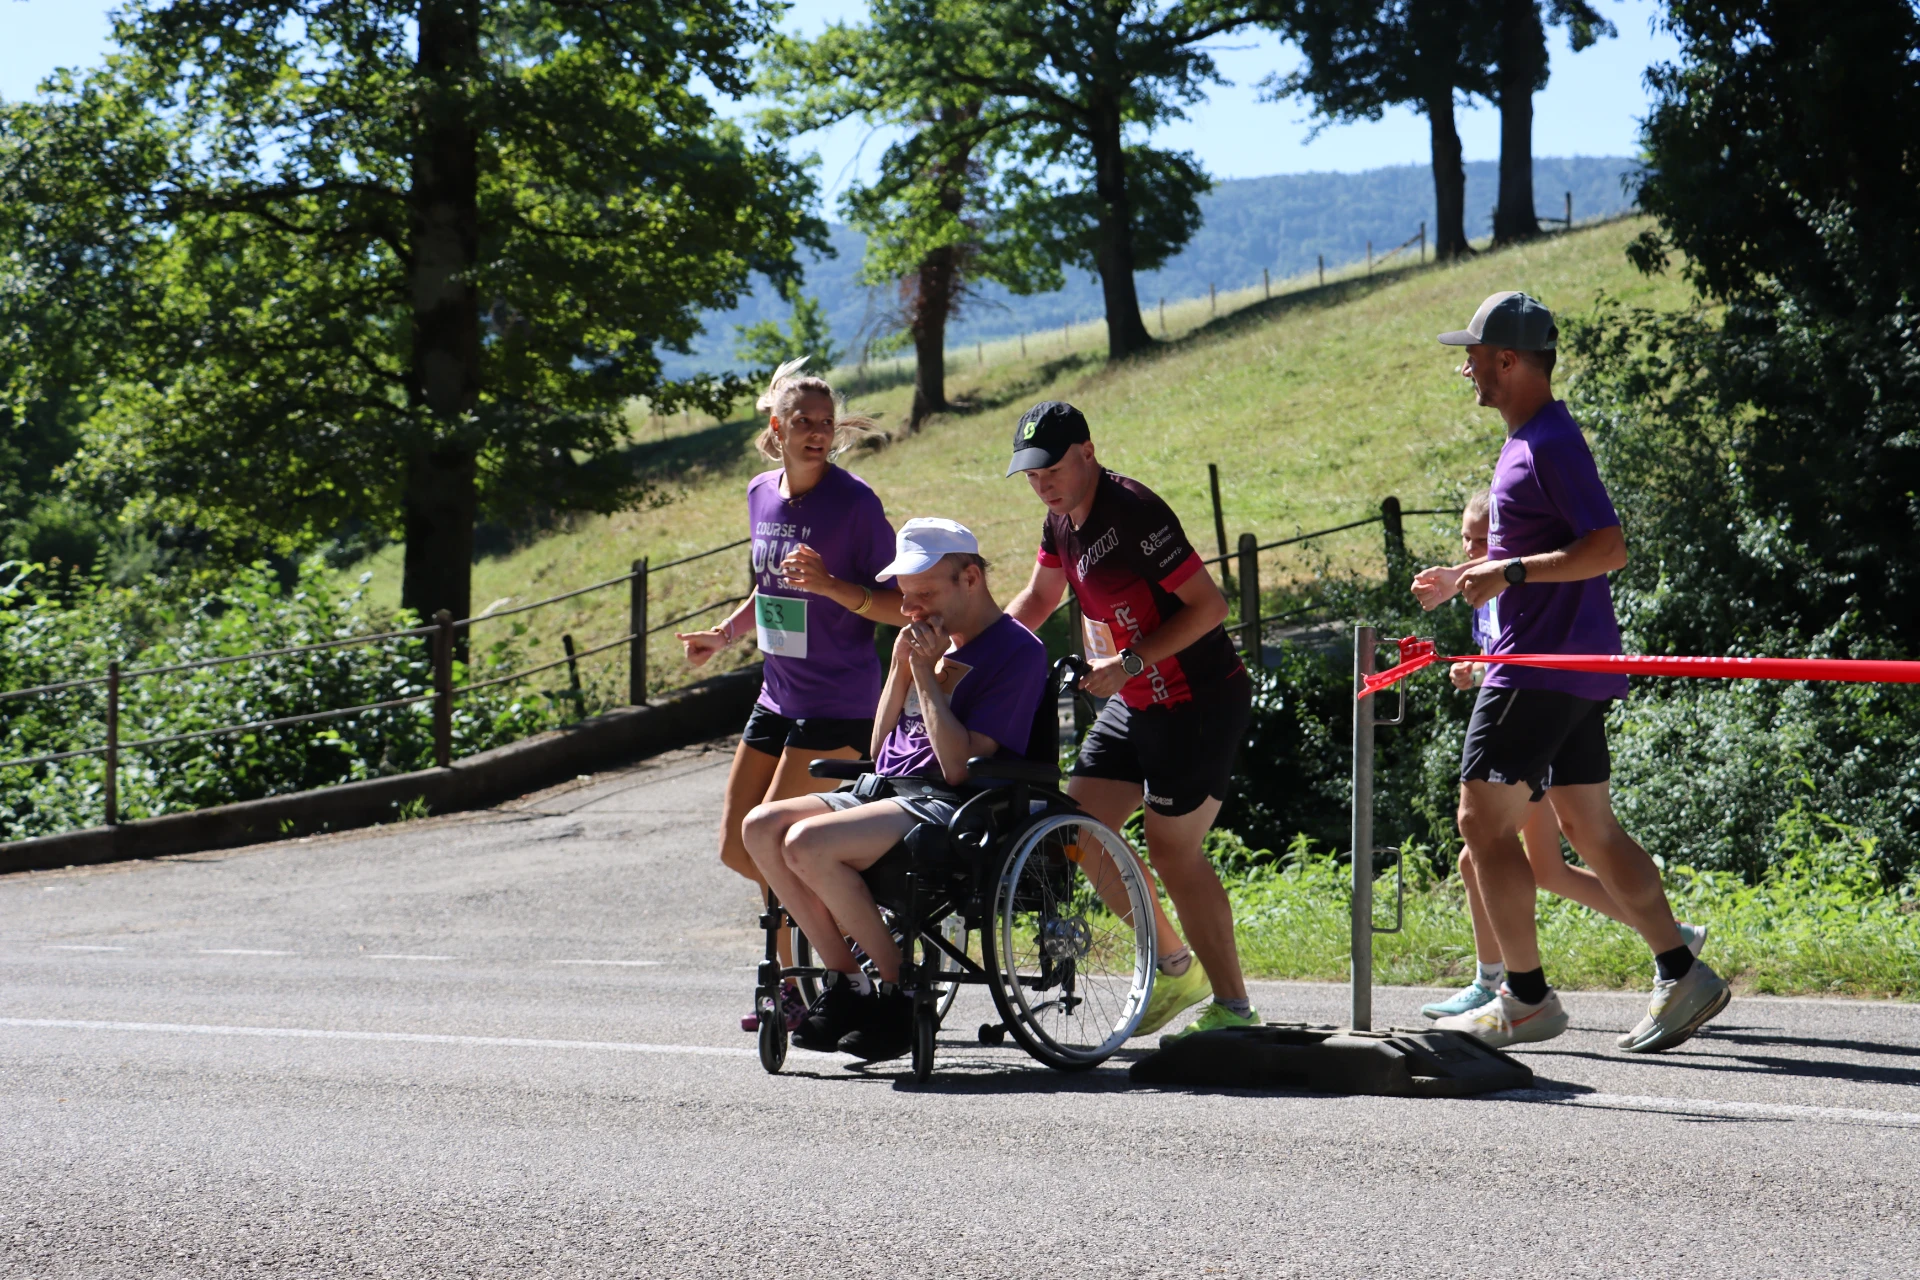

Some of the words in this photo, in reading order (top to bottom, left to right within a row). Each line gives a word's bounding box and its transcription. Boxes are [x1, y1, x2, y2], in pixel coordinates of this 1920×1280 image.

[756, 521, 797, 538] COURSE
[1088, 527, 1119, 564] HUNT
[1159, 550, 1178, 568] CRAFT
[764, 602, 784, 624] 53
